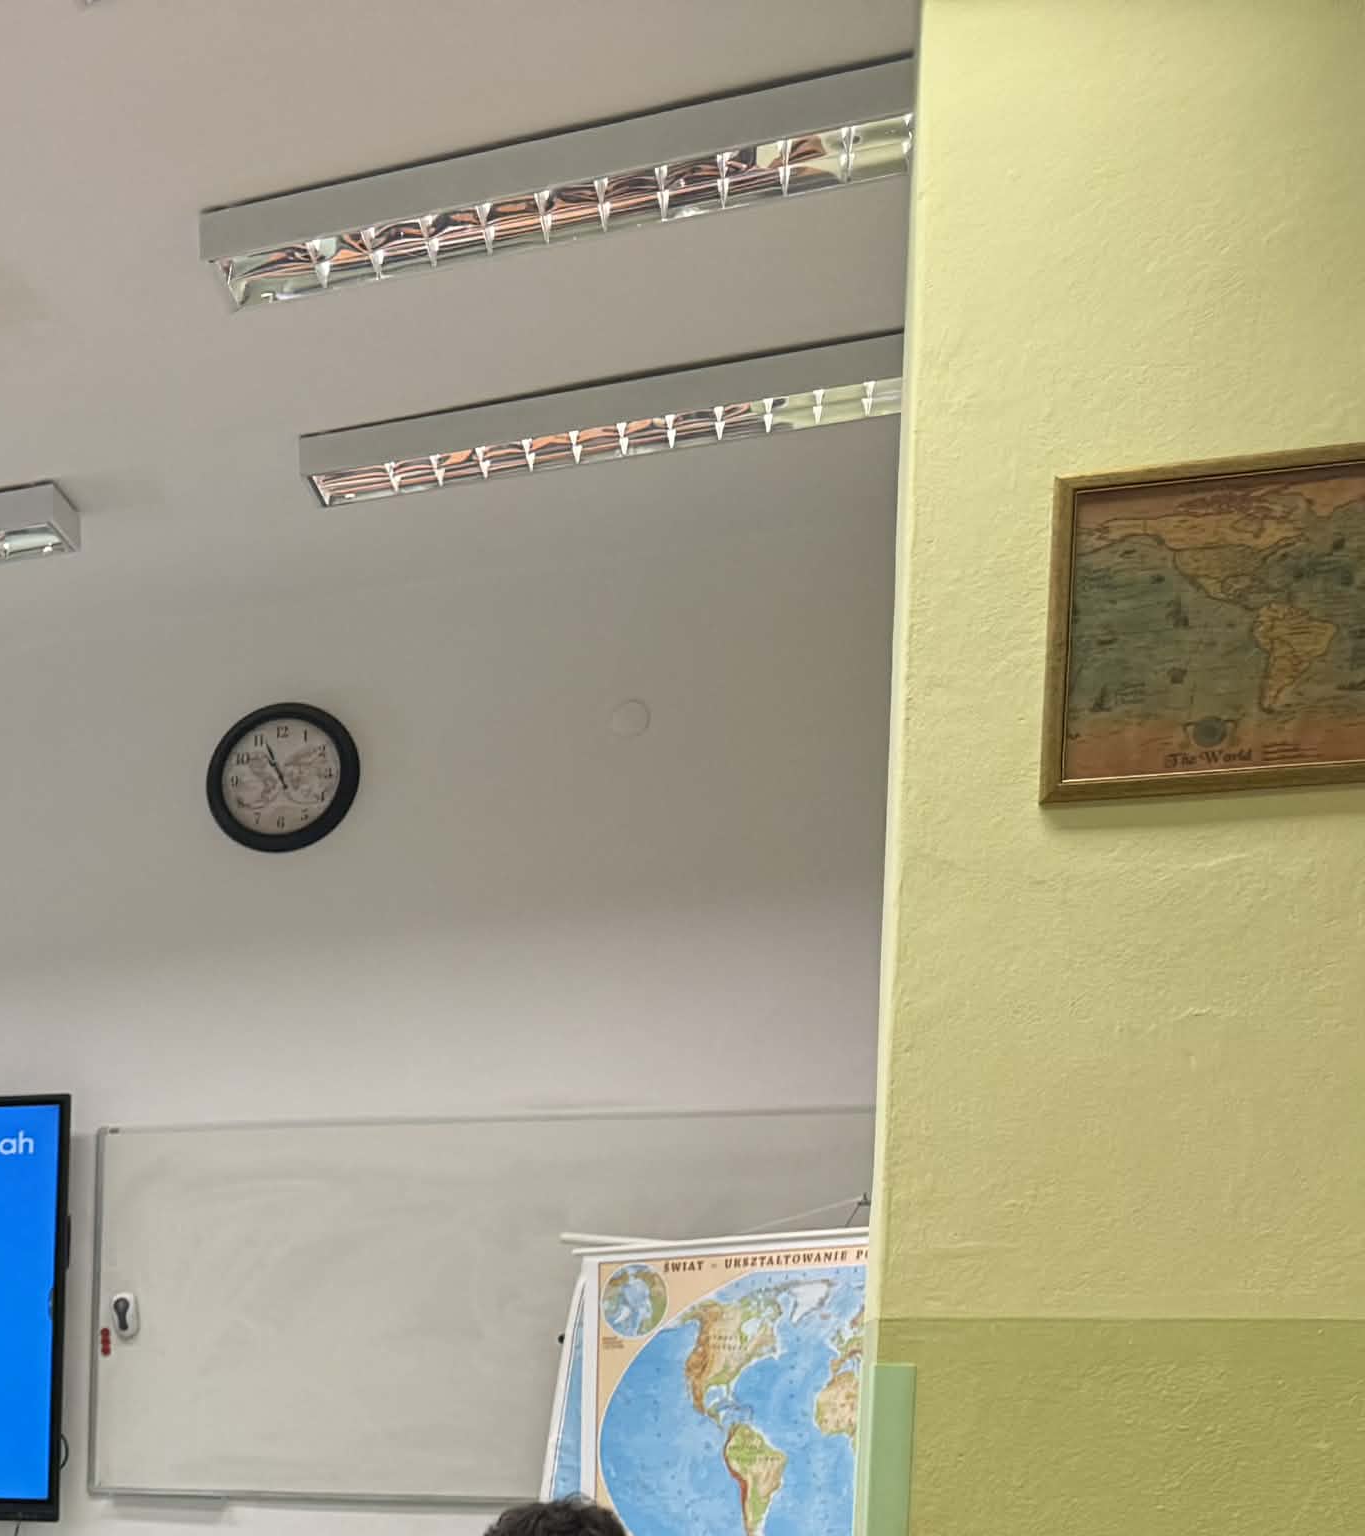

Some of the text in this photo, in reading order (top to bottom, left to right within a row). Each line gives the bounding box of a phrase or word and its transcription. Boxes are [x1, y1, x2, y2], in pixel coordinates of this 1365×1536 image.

[277, 726, 289, 738] 12
[303, 729, 308, 742] 1
[254, 734, 264, 747] 11
[236, 753, 250, 765] 10
[1166, 749, 1252, 767] The World
